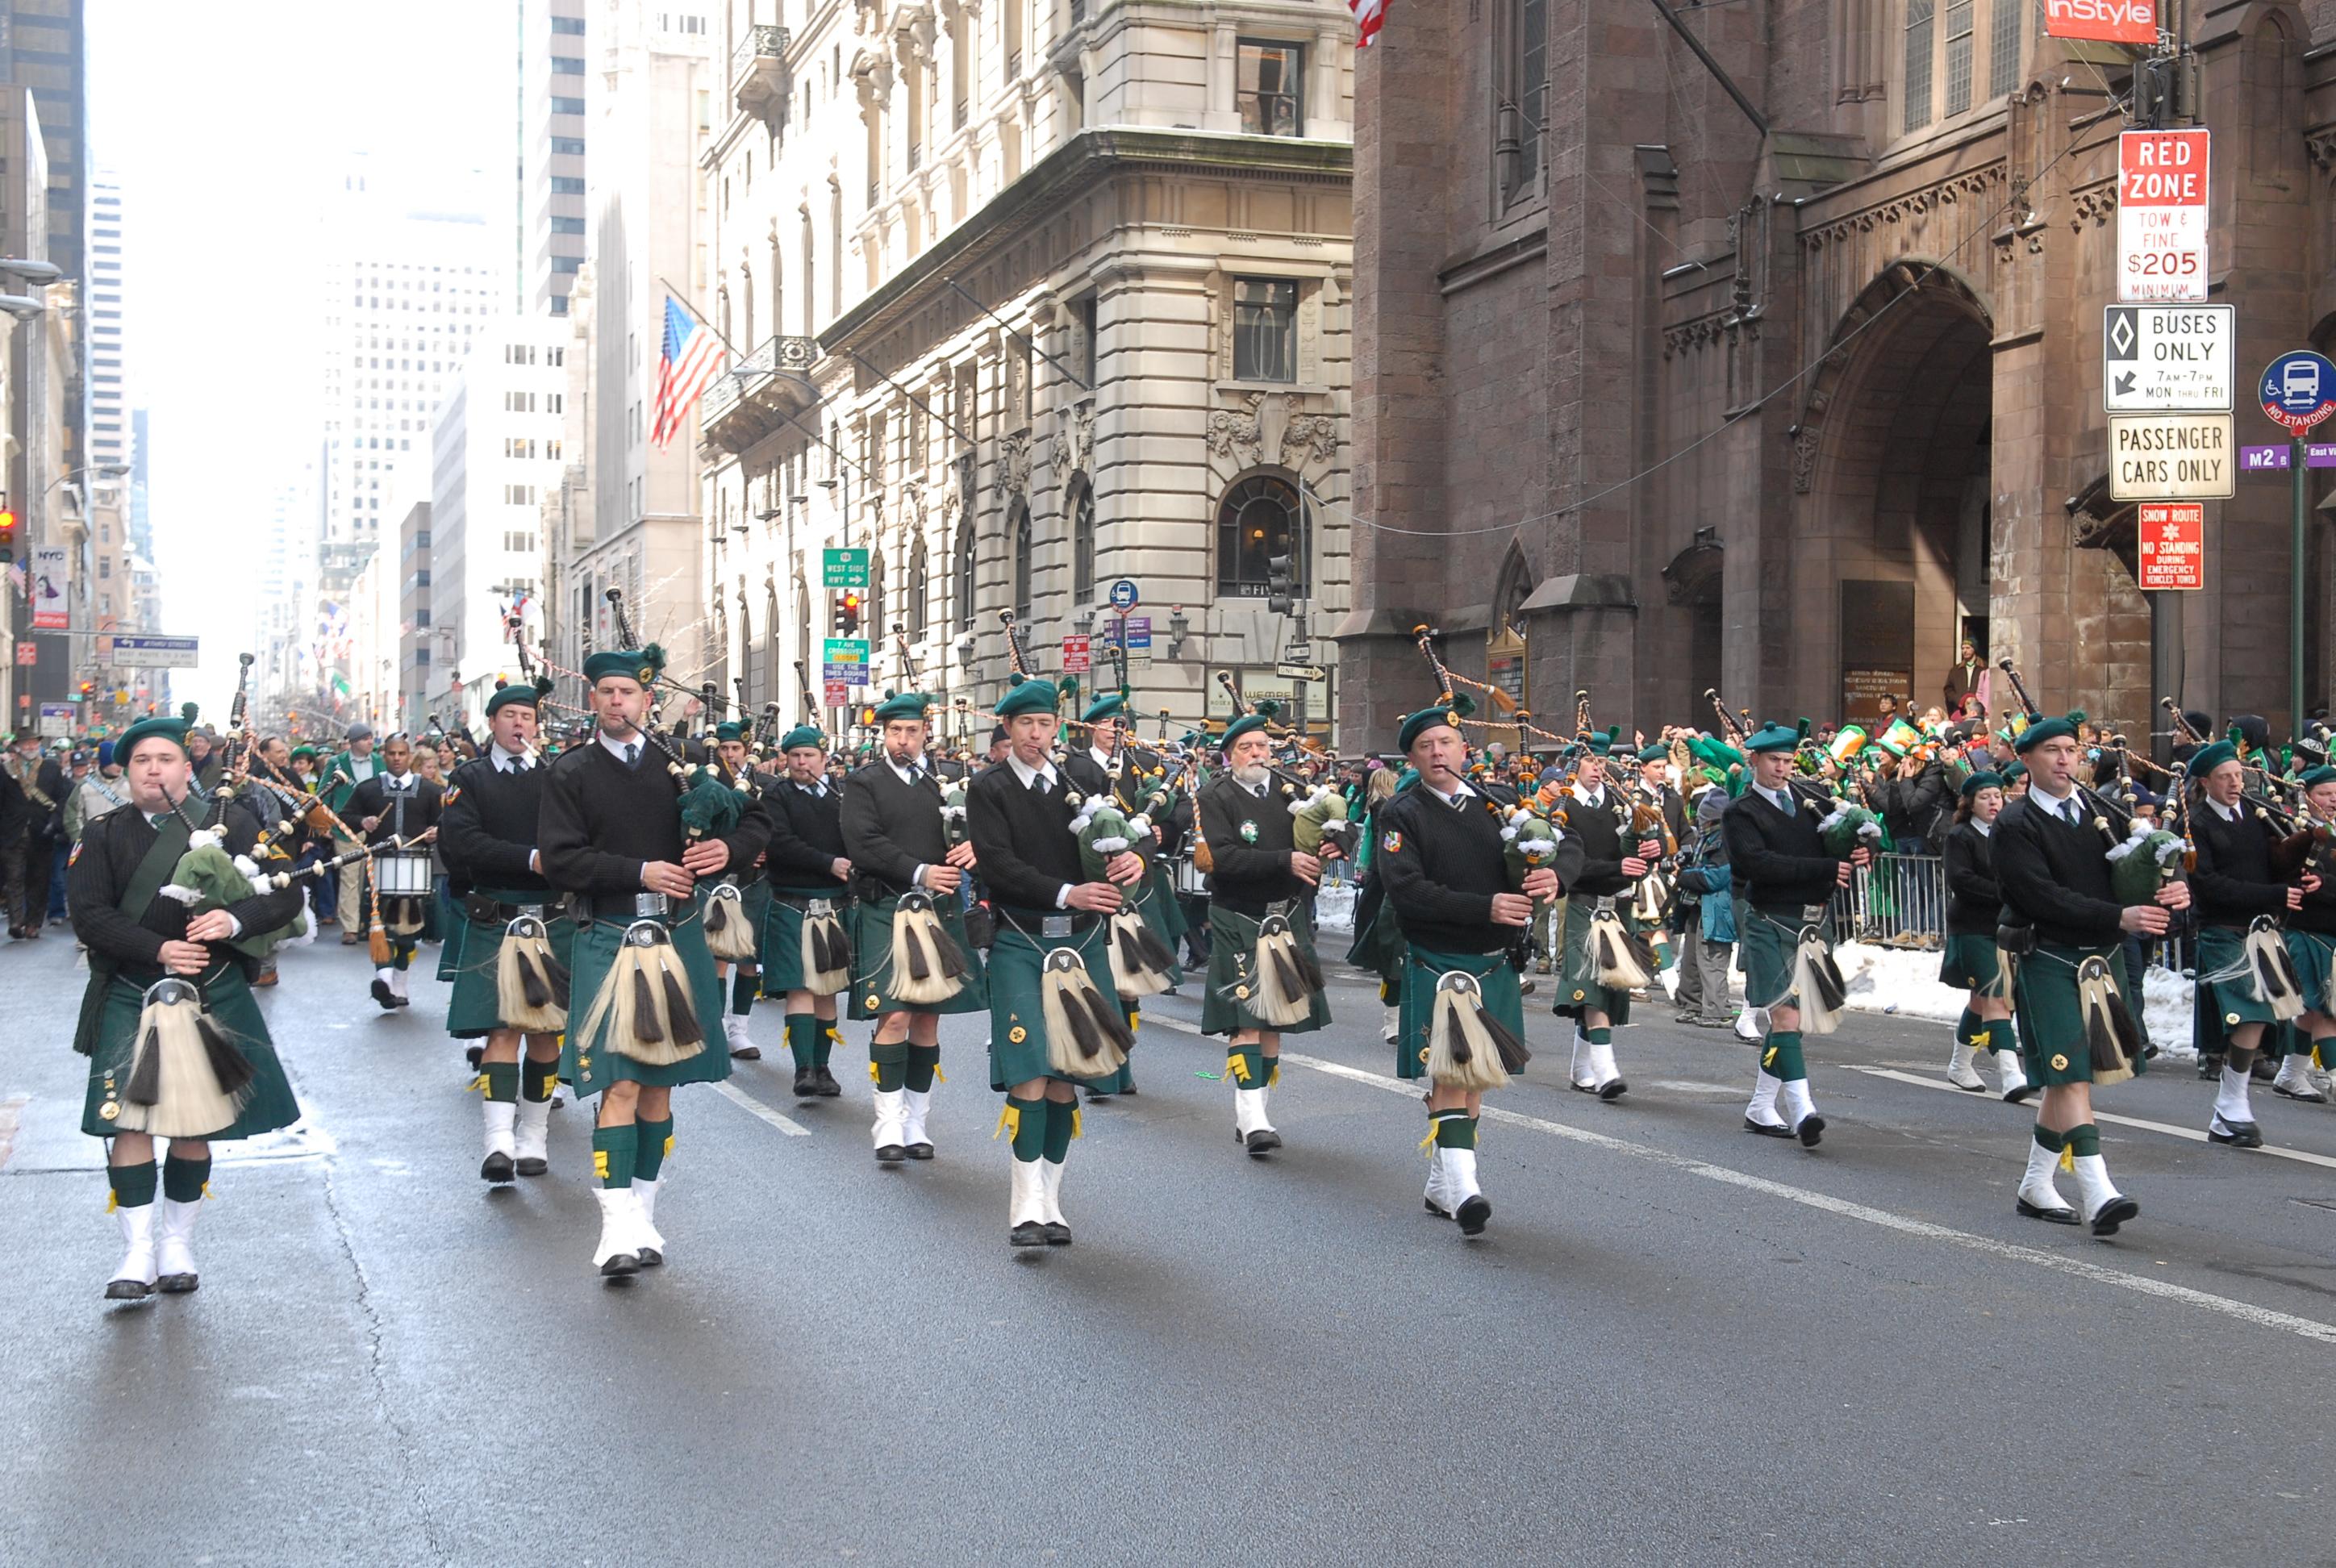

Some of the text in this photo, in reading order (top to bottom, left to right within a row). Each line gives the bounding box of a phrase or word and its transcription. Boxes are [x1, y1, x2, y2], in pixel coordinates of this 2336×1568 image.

[2048, 0, 2152, 26] InStyle
[2139, 141, 2191, 166] RED
[2130, 173, 2196, 198] ZONE
[2139, 210, 2188, 227] TOW &
[2143, 232, 2179, 248] FINE
[2128, 252, 2196, 275] $205
[2132, 283, 2188, 295] MINIMUM
[2153, 315, 2217, 334] BUSES
[2155, 342, 2214, 361] ONLY
[2146, 386, 2223, 398] MON THRU FRI
[2267, 402, 2333, 426] NO STANDING
[2120, 427, 2222, 451] PASSENGER
[2250, 448, 2274, 466] M2
[2310, 448, 2326, 456] East
[2123, 459, 2221, 483] CARS ONLY
[2142, 510, 2200, 522] SNOW ROUTE
[2142, 541, 2200, 554] NO STANDING
[38, 552, 64, 561] NYC
[2156, 555, 2186, 564] DURING
[2146, 565, 2194, 574] EMERGENCY
[2146, 574, 2196, 584] VEHICLES TOWED
[1245, 690, 1291, 699] WEMPE
